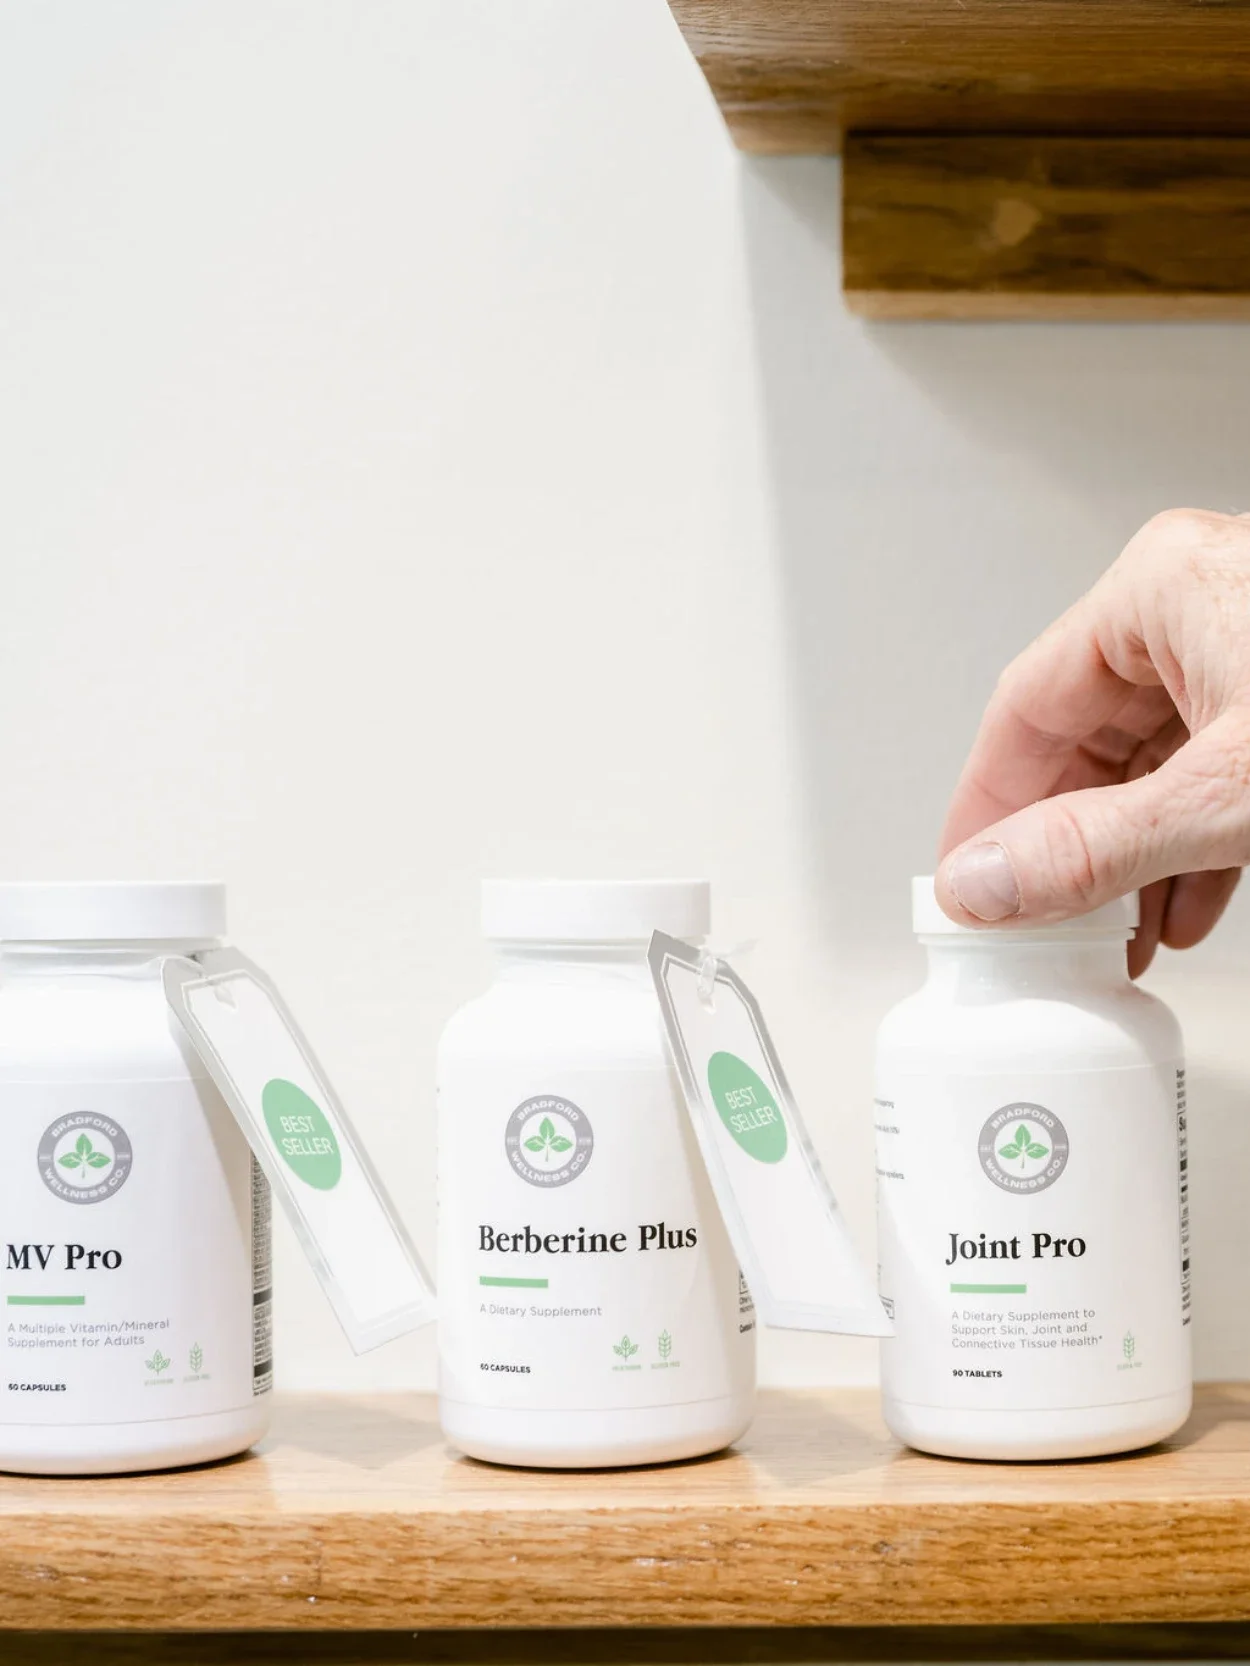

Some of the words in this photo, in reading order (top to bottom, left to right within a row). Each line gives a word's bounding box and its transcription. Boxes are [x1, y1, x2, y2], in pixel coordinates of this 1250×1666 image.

[725, 1086, 758, 1109] BEST
[517, 1100, 579, 1121] BRADFORD
[730, 1106, 778, 1133] SELLER
[991, 1108, 1054, 1129] BRADFORD
[51, 1116, 118, 1137] BRADFORD
[280, 1115, 315, 1133] BEST
[281, 1137, 333, 1155] SELLER
[511, 1150, 570, 1182] WELLNESS
[985, 1158, 1046, 1189] WELLNESS
[44, 1166, 108, 1198] WELLNESS
[479, 1226, 626, 1253] Berberine
[639, 1222, 697, 1250] Plus
[7, 1245, 54, 1270] MV
[65, 1245, 122, 1269] Pro
[946, 1234, 1021, 1265] Joint
[1032, 1233, 1086, 1258] Pro
[480, 1304, 487, 1313] A
[490, 1305, 526, 1317] Dietary
[530, 1306, 602, 1318] Supplement
[952, 1311, 959, 1320] A
[963, 1311, 1003, 1323] Dietary
[1007, 1309, 1079, 1322] Supplement
[1084, 1309, 1096, 1318] to
[8, 1323, 16, 1332] A
[18, 1322, 66, 1335] Multiple
[70, 1318, 170, 1332] Vitamin/Mineral
[951, 1324, 995, 1337] Support
[1000, 1324, 1027, 1335] Skin,
[1032, 1323, 1062, 1333] Joint
[1067, 1323, 1087, 1333] and
[8, 1336, 78, 1348] Supplement
[81, 1336, 99, 1346] for
[104, 1334, 145, 1345] Adults
[952, 1338, 1016, 1349] Connective
[1020, 1337, 1057, 1348] Tissue
[491, 1364, 531, 1373] CAPSULES
[953, 1369, 964, 1378] 90
[965, 1369, 1002, 1378] TABLETS
